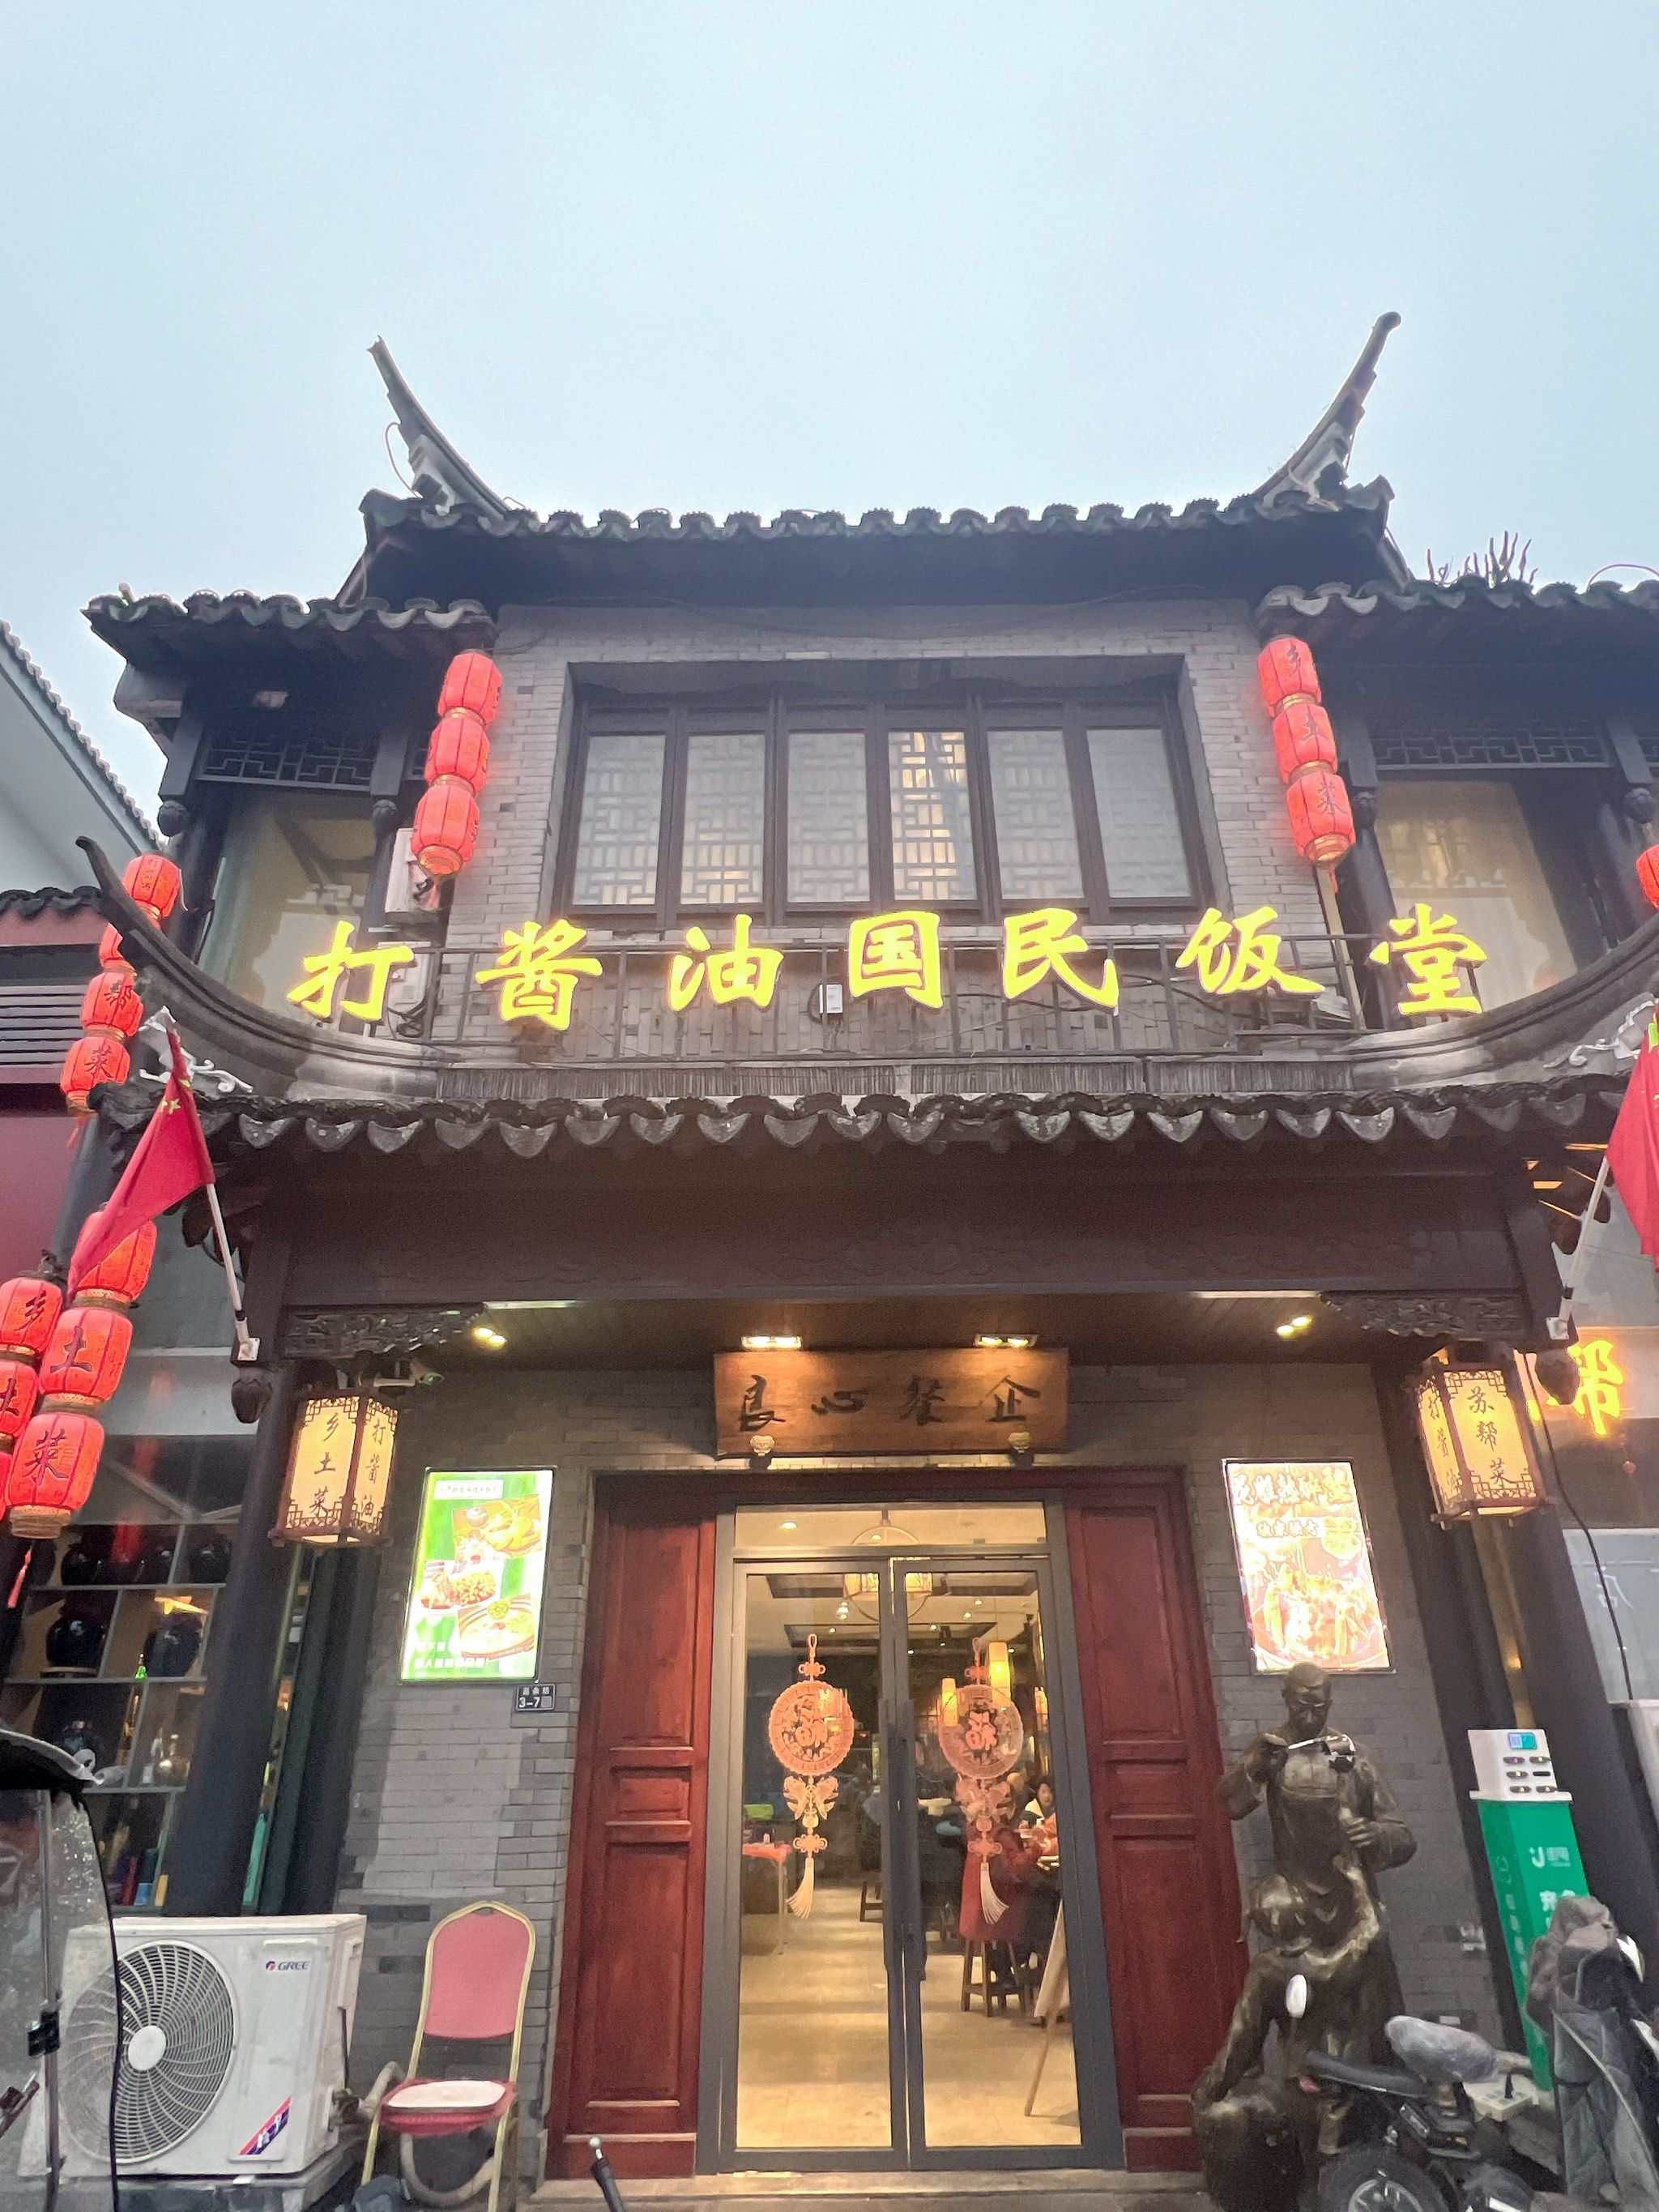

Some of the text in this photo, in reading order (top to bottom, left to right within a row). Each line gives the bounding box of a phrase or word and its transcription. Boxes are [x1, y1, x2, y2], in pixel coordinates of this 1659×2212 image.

[288, 903, 1489, 1031] 打酱油国民饭堂
[309, 1412, 339, 1518] 乡土菜
[278, 1961, 309, 1971] GREE
